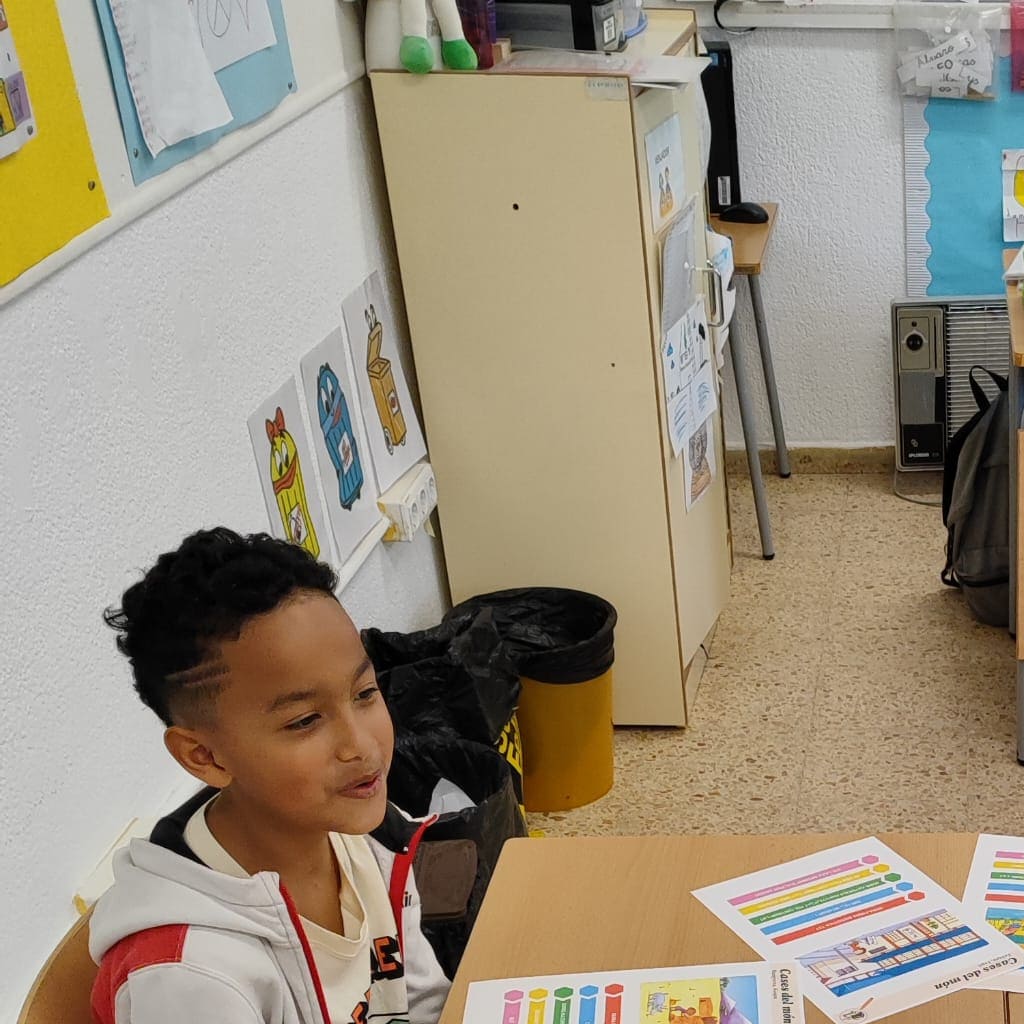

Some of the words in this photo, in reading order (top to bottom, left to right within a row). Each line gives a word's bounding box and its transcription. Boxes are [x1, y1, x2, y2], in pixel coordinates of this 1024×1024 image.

[980, 956, 1020, 974] Cases
[778, 967, 793, 991] Cases
[960, 968, 985, 981] del
[931, 976, 965, 991] món
[780, 991, 794, 1005] del
[781, 1005, 796, 1024] món
